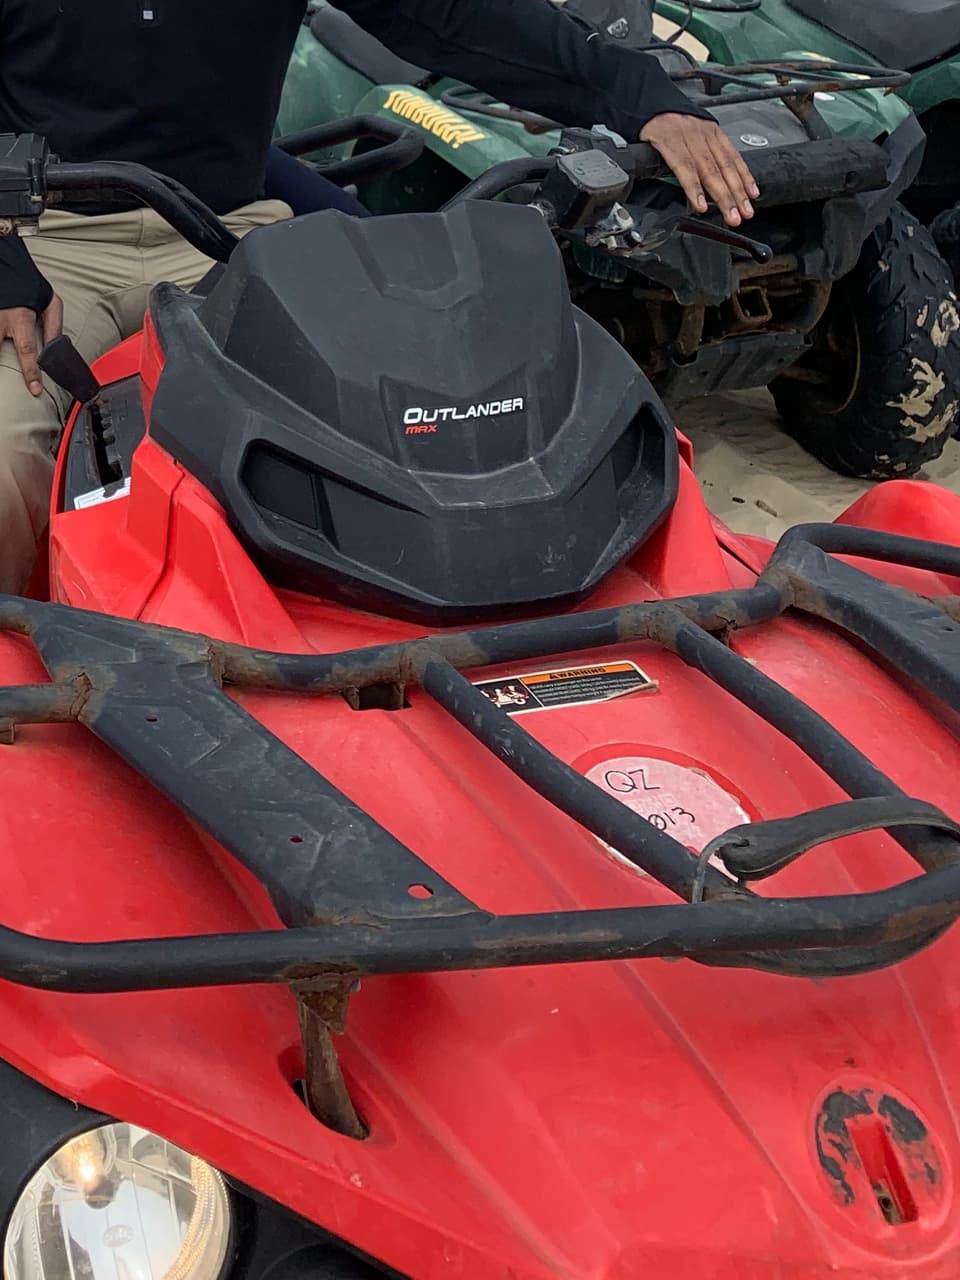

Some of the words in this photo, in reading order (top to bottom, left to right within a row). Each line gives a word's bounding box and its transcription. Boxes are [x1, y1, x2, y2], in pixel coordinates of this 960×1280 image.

[403, 397, 524, 424] OUTLANDER
[557, 667, 607, 679] WARNING
[605, 769, 661, 793] QZ
